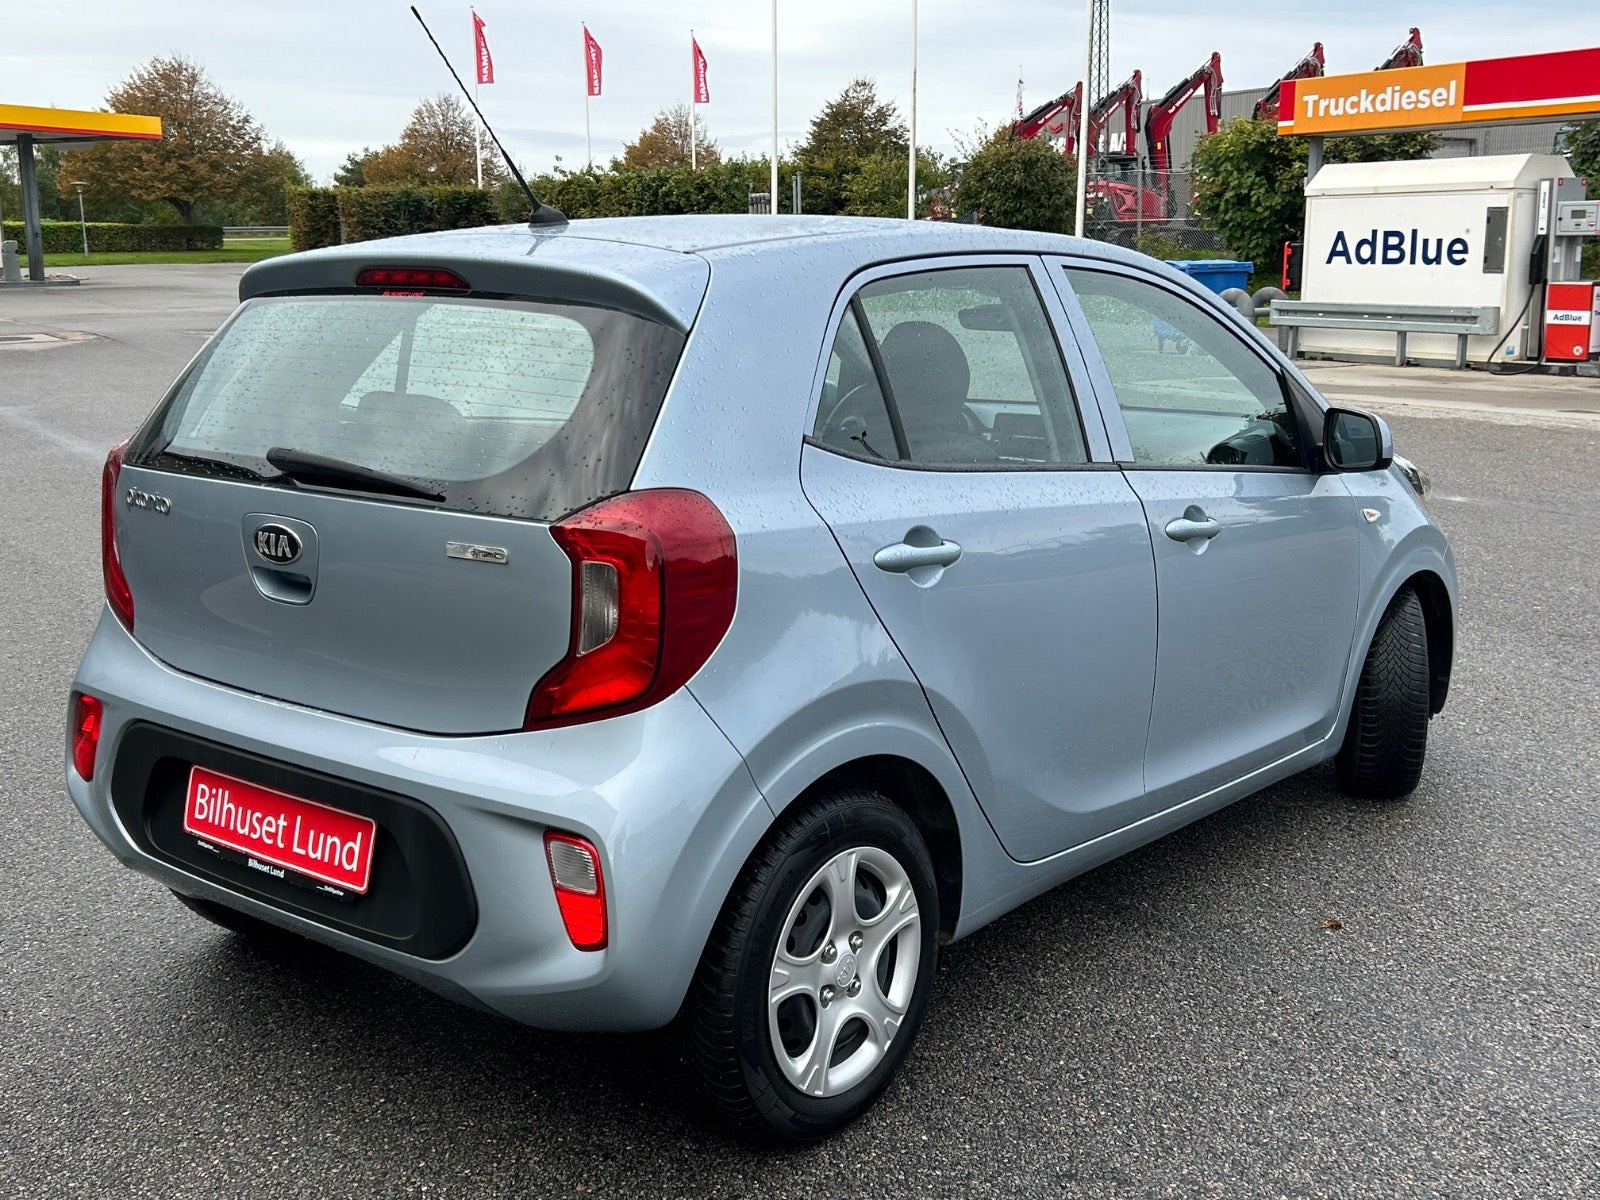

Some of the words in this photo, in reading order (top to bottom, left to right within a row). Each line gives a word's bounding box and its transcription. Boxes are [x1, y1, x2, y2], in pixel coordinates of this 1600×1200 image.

[1303, 80, 1457, 118] Truckdiesel
[1326, 229, 1469, 266] AdBlue
[257, 531, 292, 558] KIA
[194, 783, 288, 849] Bilhuset
[292, 815, 362, 872] Lund
[248, 858, 270, 875] Bilhuset
[270, 865, 285, 879] Lund
